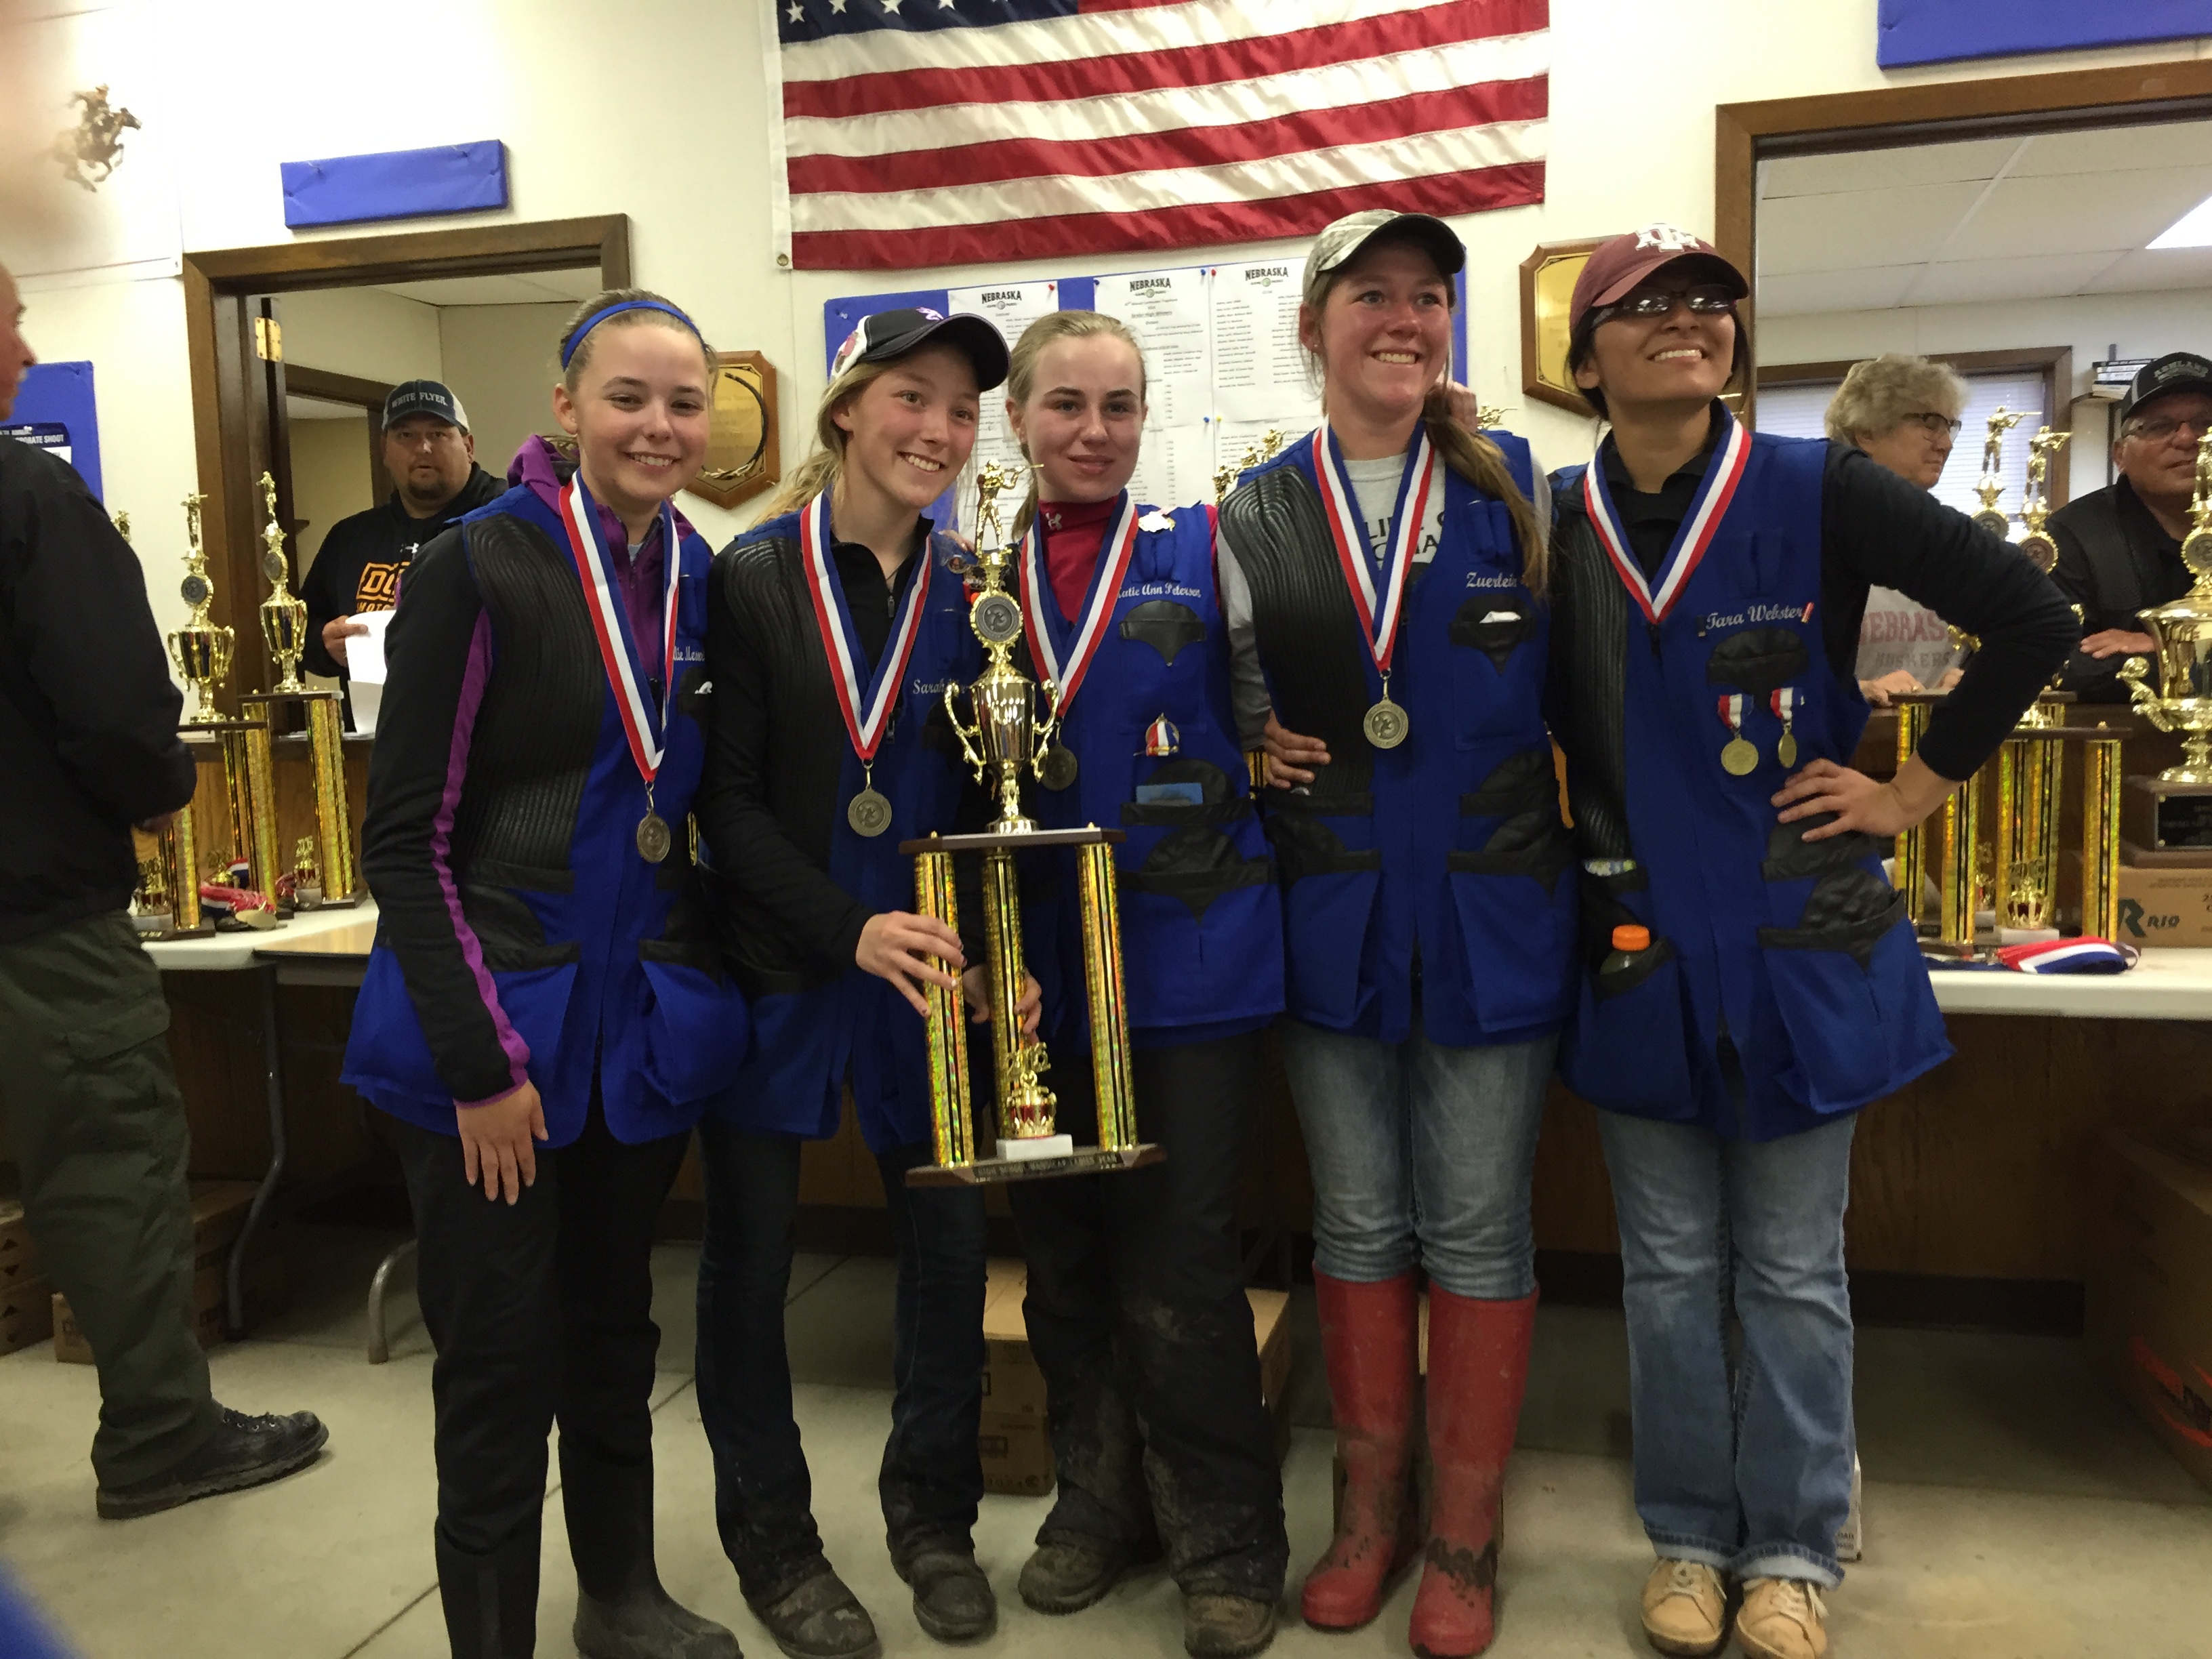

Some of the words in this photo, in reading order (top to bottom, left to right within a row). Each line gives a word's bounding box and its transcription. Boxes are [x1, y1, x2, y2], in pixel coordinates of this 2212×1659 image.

[1245, 267, 1289, 281] NEBRASKA
[1129, 277, 1171, 292] NEBRASKA
[981, 290, 1022, 304] NEBRASKA
[392, 392, 416, 408] WHITE
[1118, 586, 1140, 598] atie
[1705, 612, 1745, 630] Tara
[1747, 603, 1803, 622] Webster
[912, 678, 945, 694] Sarah
